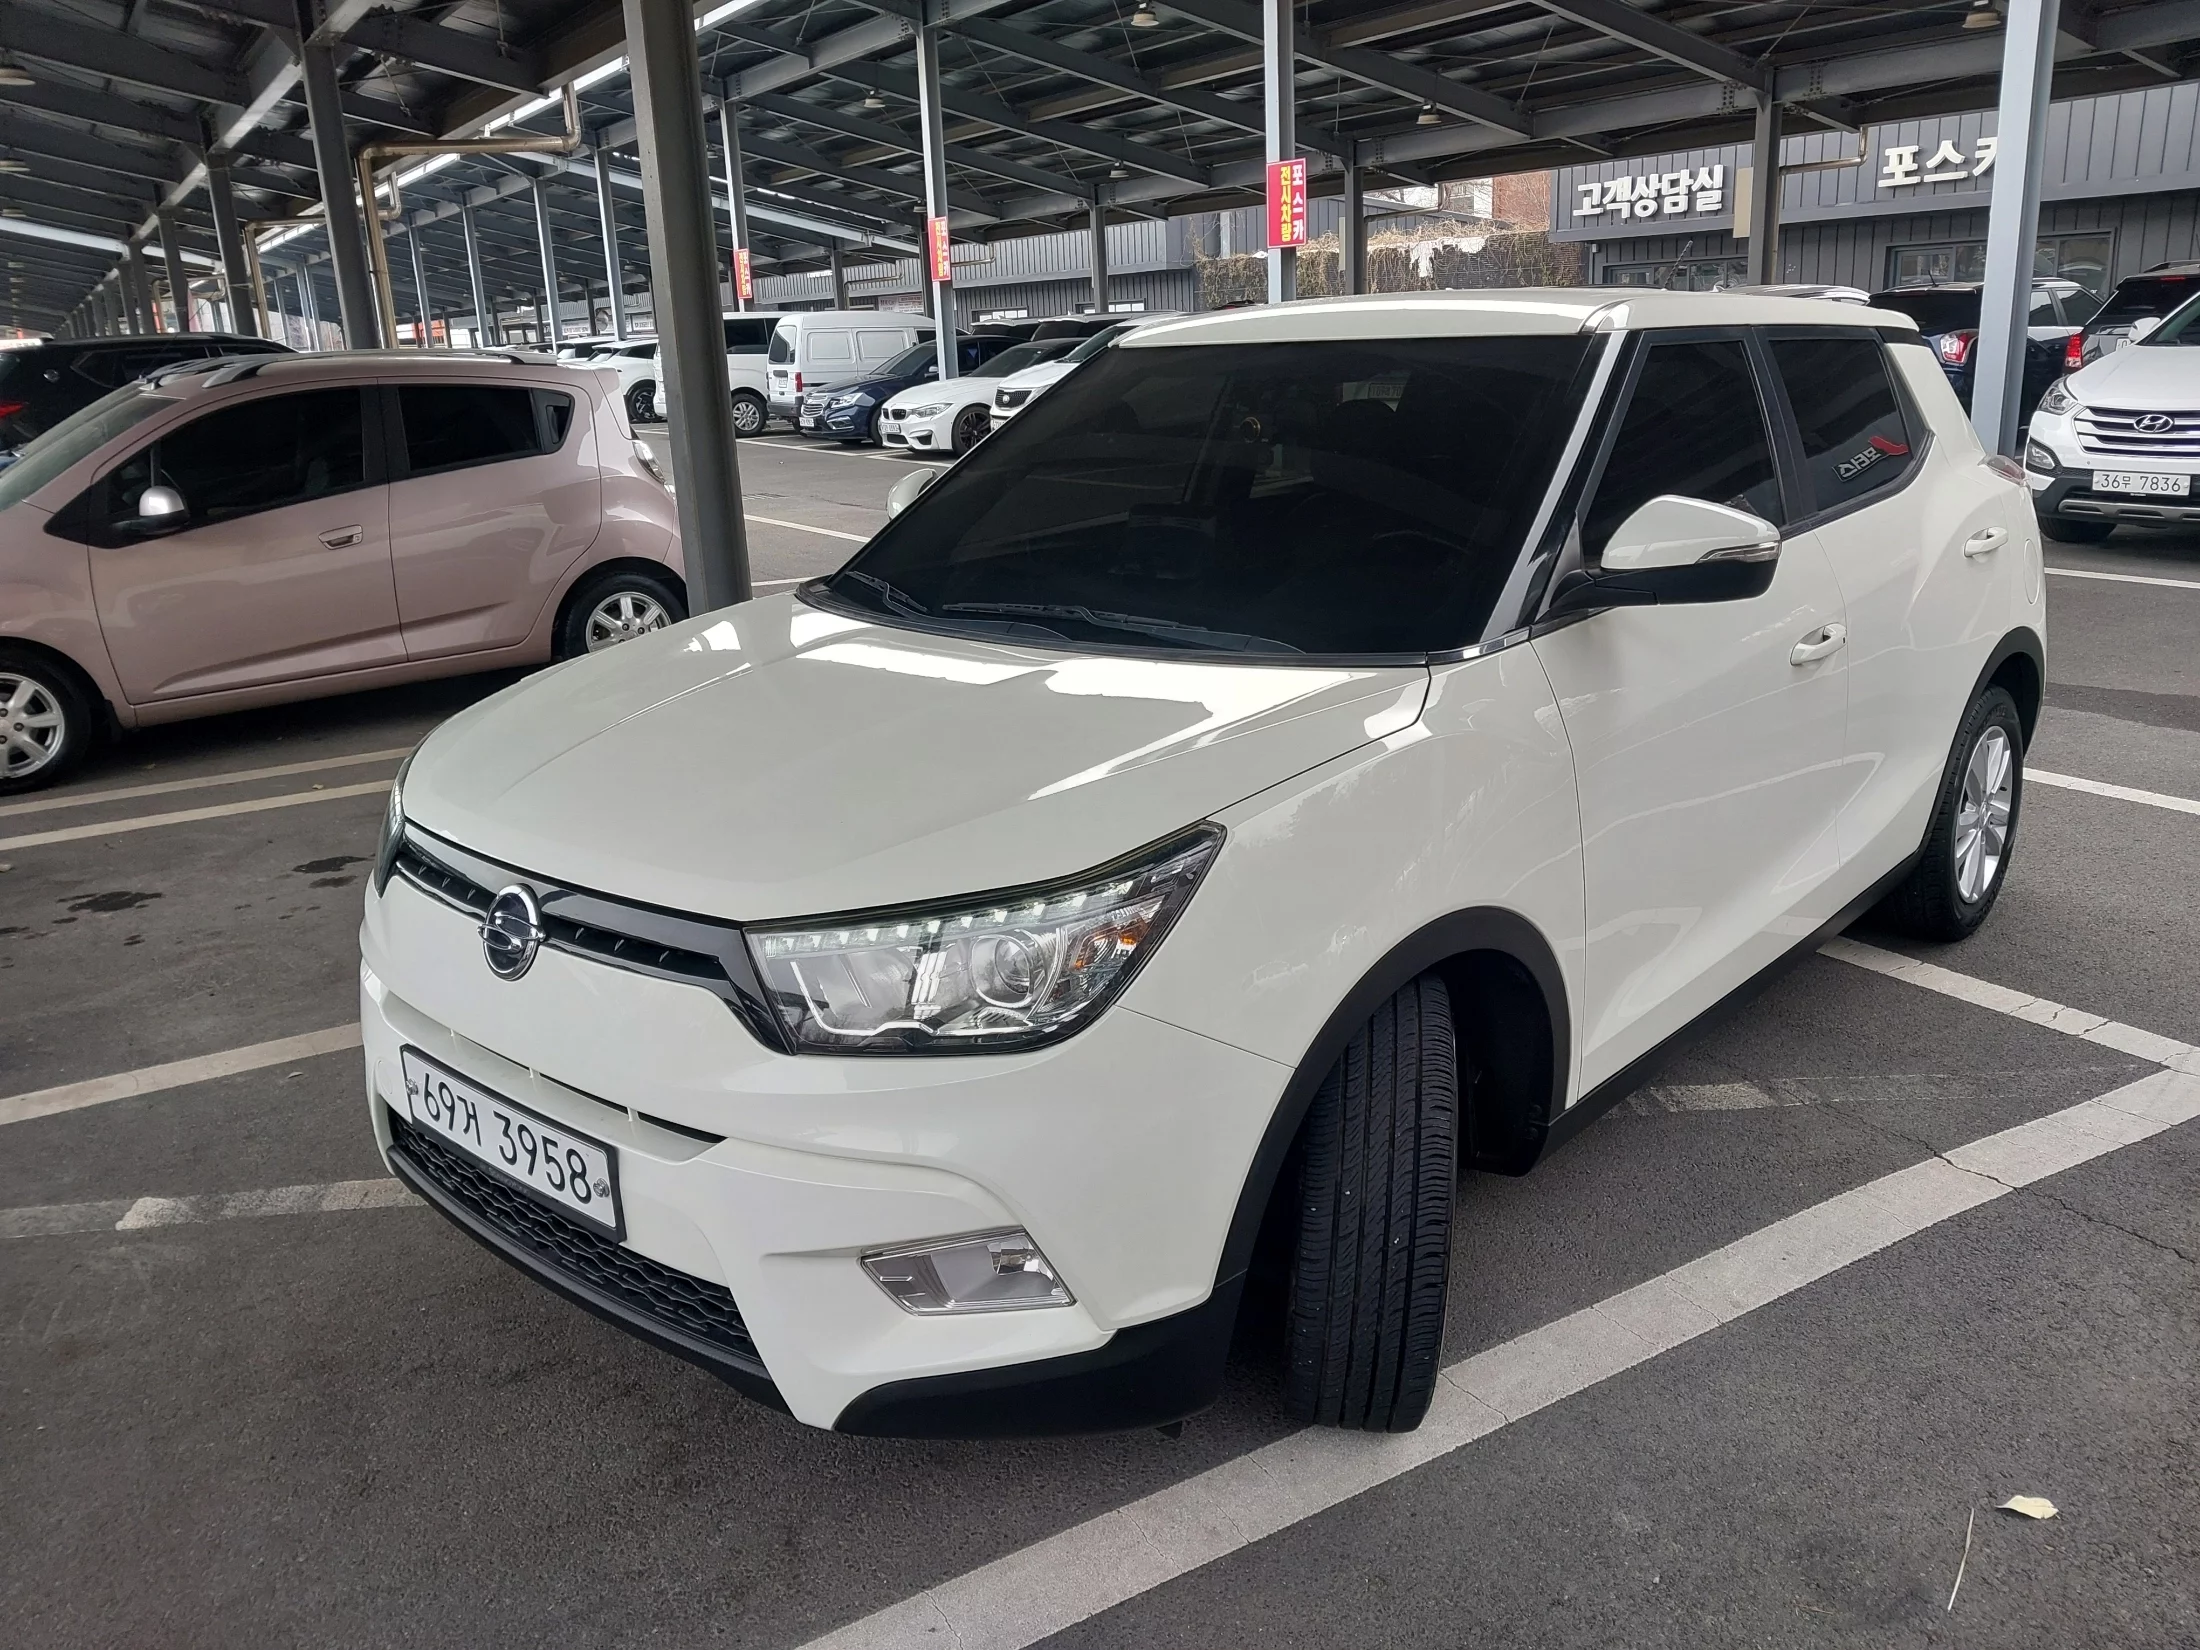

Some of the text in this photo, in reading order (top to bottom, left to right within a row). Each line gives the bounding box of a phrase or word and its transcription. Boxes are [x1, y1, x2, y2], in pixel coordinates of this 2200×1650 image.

[1280, 165, 1292, 242] 전시차량
[1292, 164, 1304, 240] 포스카
[1572, 164, 1724, 219] 고객상담실
[2101, 473, 2181, 492] 36무 7836
[423, 1072, 482, 1147] 69거
[492, 1110, 592, 1204] 3958
